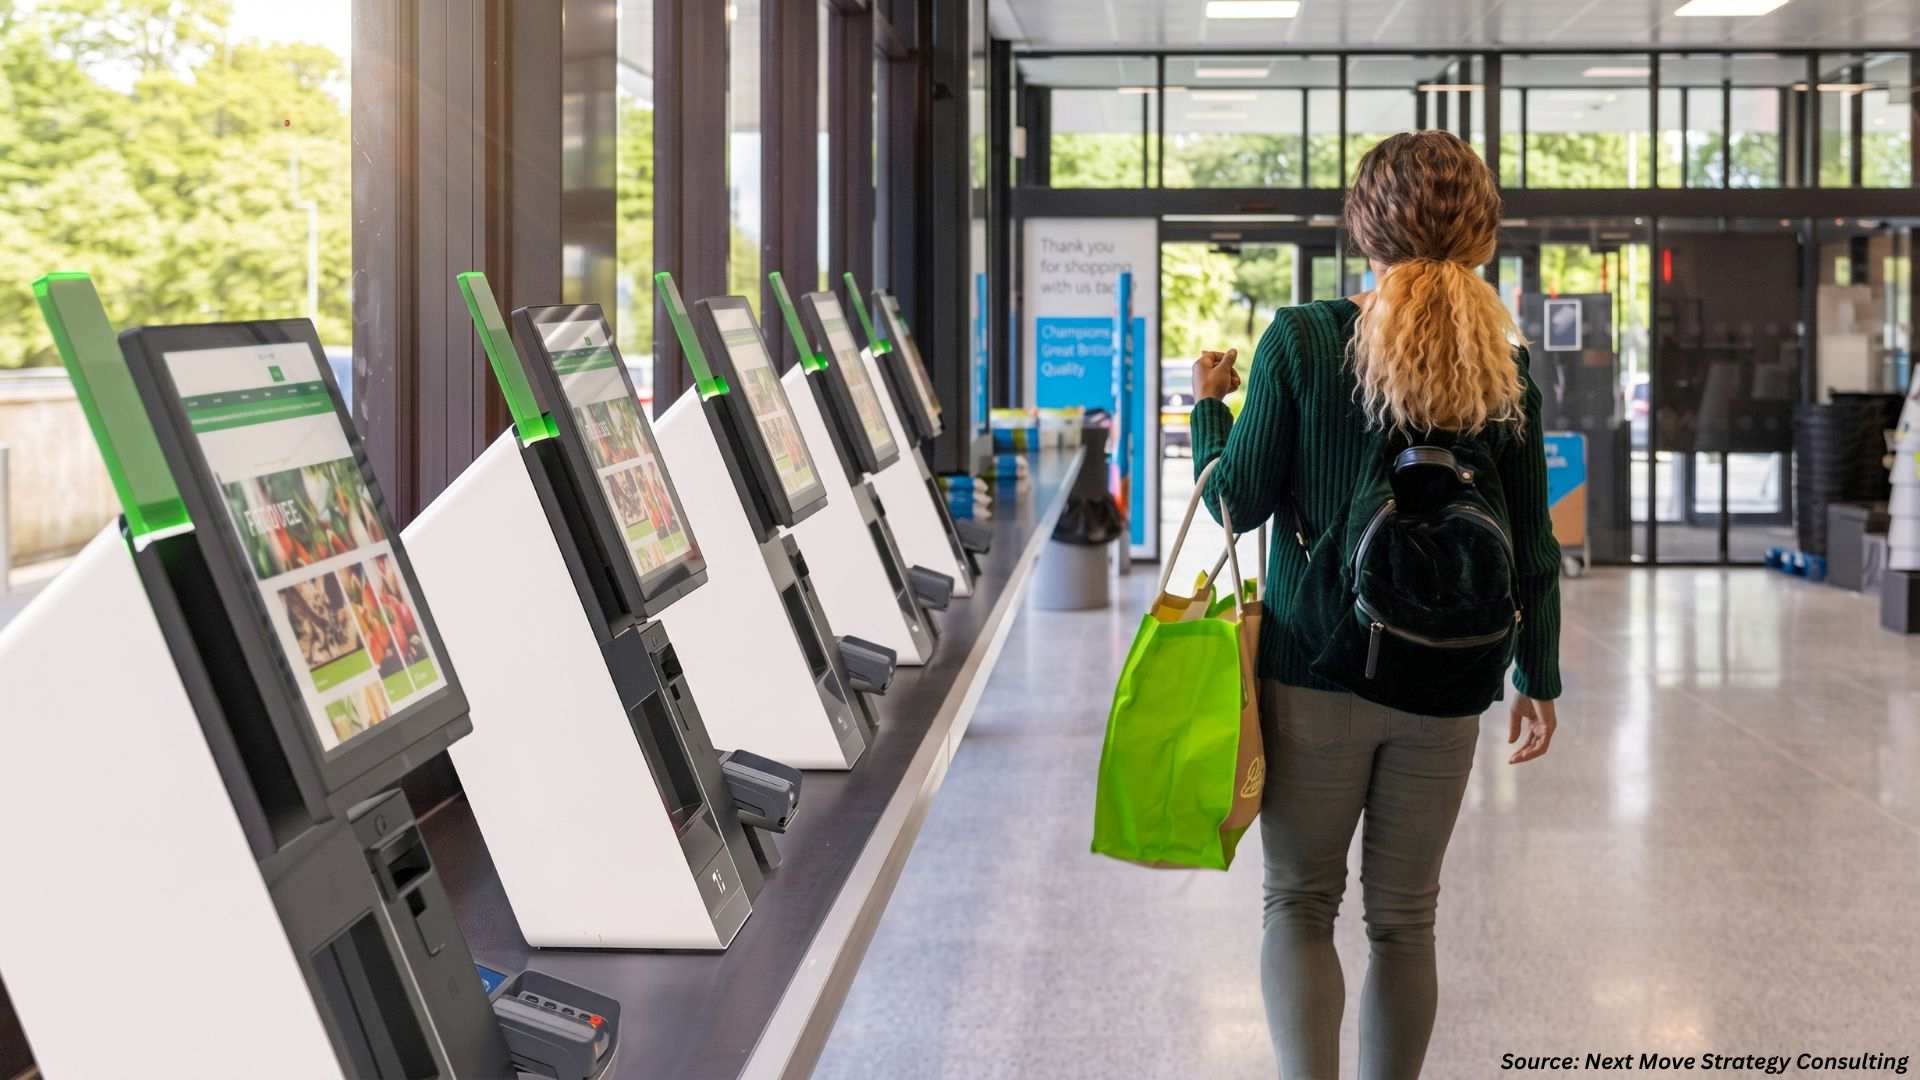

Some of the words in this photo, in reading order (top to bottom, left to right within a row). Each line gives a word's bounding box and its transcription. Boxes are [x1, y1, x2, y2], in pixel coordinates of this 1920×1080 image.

[1040, 237, 1083, 253] Thank
[1087, 241, 1115, 258] you
[1040, 258, 1060, 273] for
[1041, 279, 1073, 295] with
[1075, 283, 1093, 295] us
[1041, 361, 1086, 379] Quality
